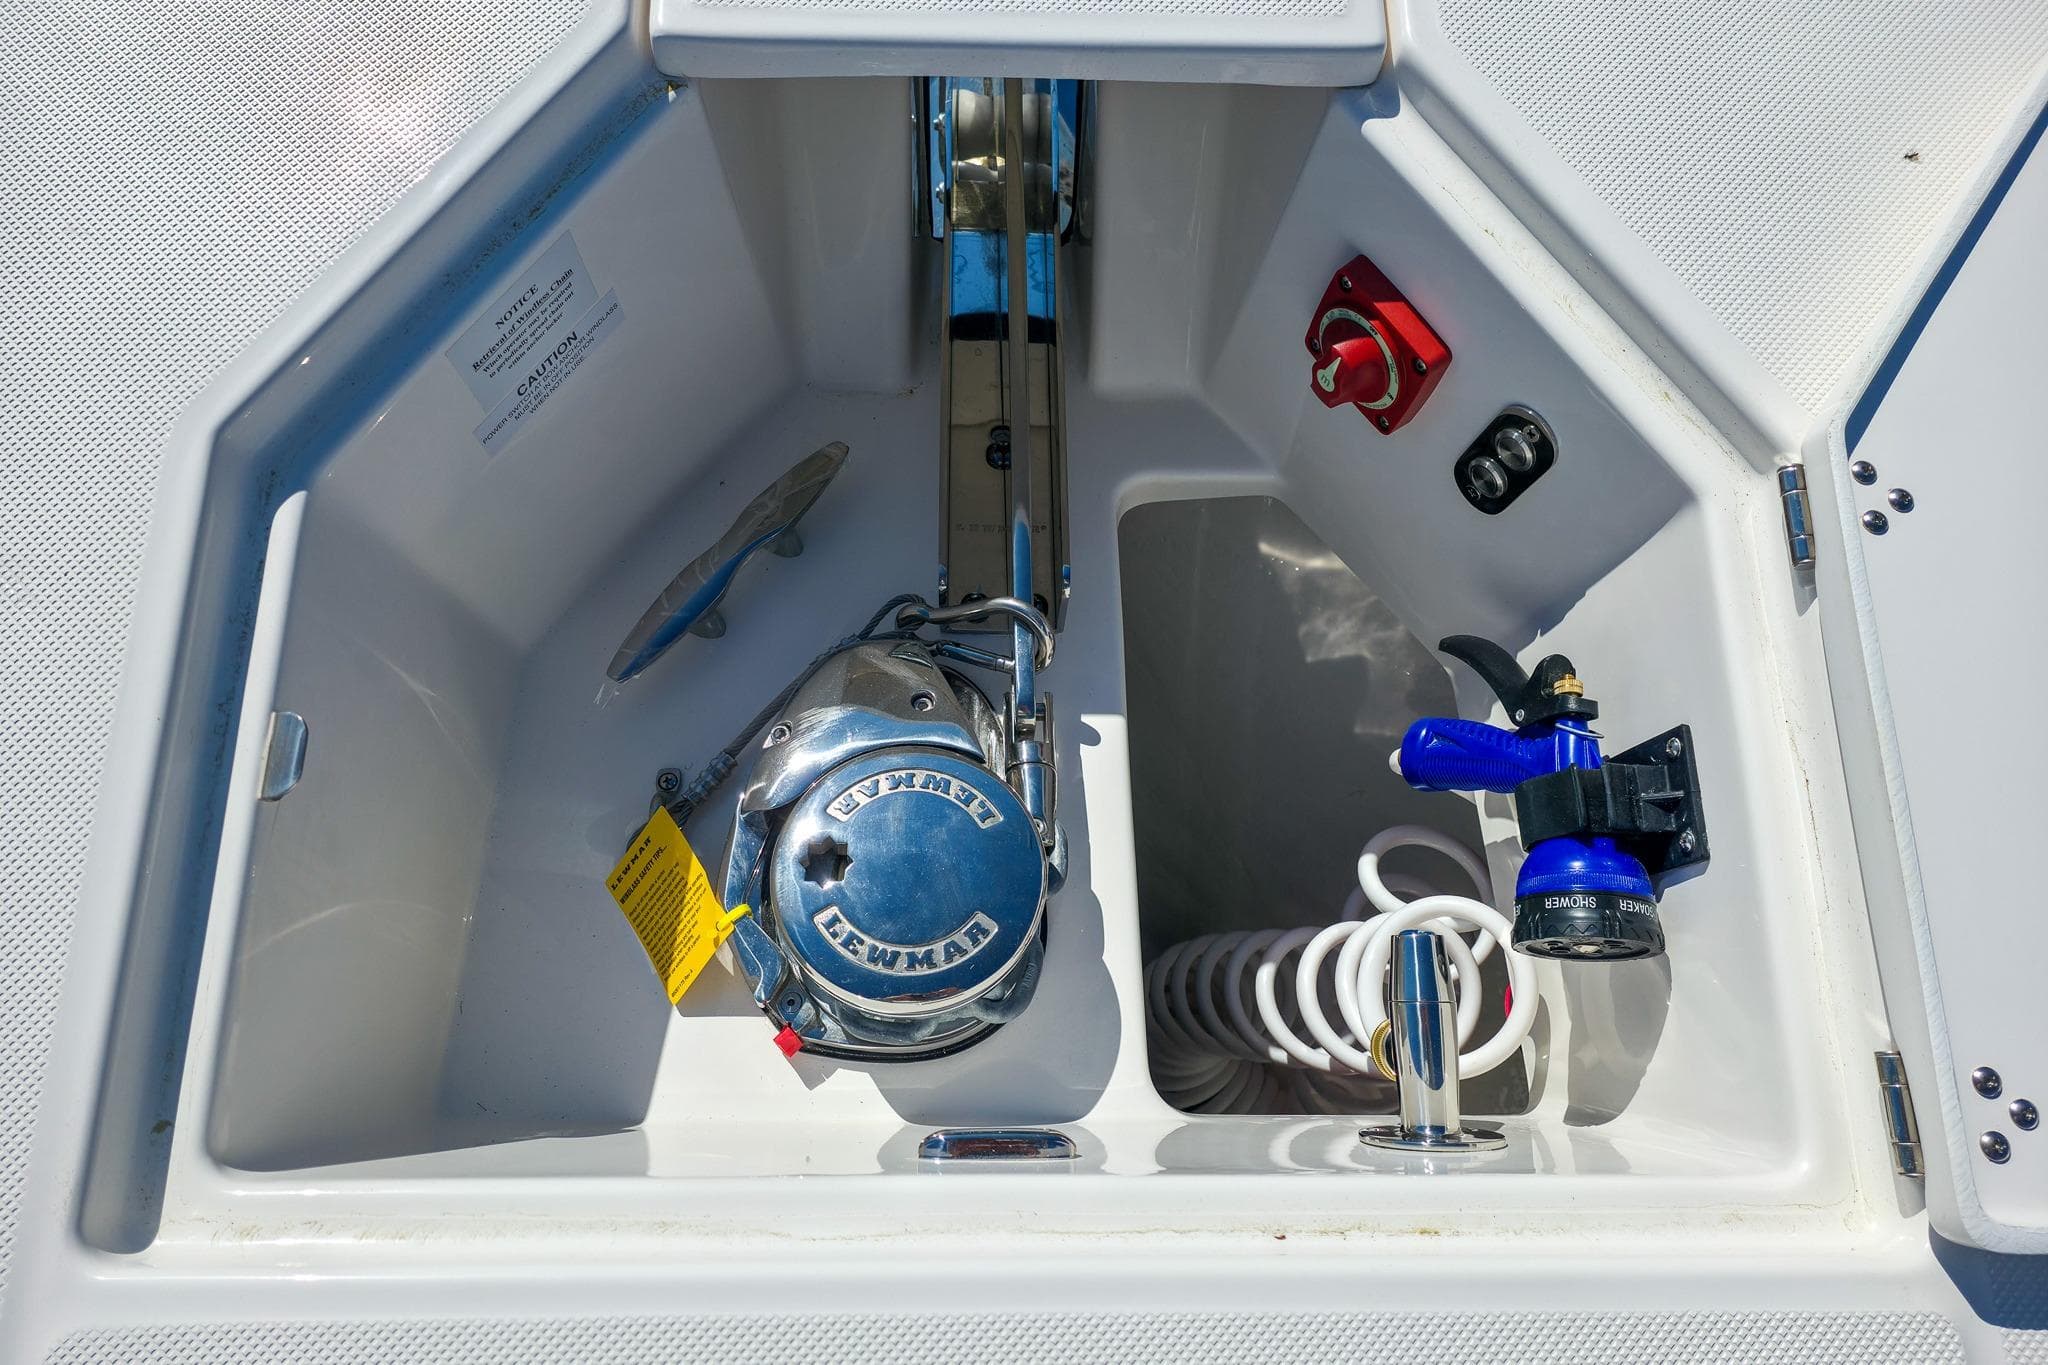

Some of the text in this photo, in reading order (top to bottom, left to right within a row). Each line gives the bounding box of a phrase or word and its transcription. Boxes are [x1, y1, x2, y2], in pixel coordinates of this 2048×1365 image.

[472, 267, 572, 370] Retrieval of Windless Chain
[483, 281, 573, 373] Winch operator may be required
[495, 283, 538, 330] NOTICE
[489, 369, 496, 378] to
[495, 337, 529, 372] periodically
[528, 316, 549, 338] spread
[548, 301, 563, 318] chain
[507, 312, 563, 370] within anchor locker
[516, 330, 578, 397] CAUTION
[482, 302, 618, 444] POWER SWITCH AT BOW ANCHOR WINDLASS
[514, 400, 533, 421] MUST
[533, 389, 543, 401] BE
[542, 381, 551, 391] IN
[563, 335, 595, 369] POSITION
[529, 392, 549, 414] WHEN
[548, 377, 564, 394] NOT
[563, 368, 572, 378] IN
[833, 772, 996, 824] LEWMAR
[610, 835, 651, 890] LEWMAR
[638, 857, 655, 880] SAFETY
[1545, 896, 1597, 909] SHOWER
[820, 912, 991, 972] LEWMAR
